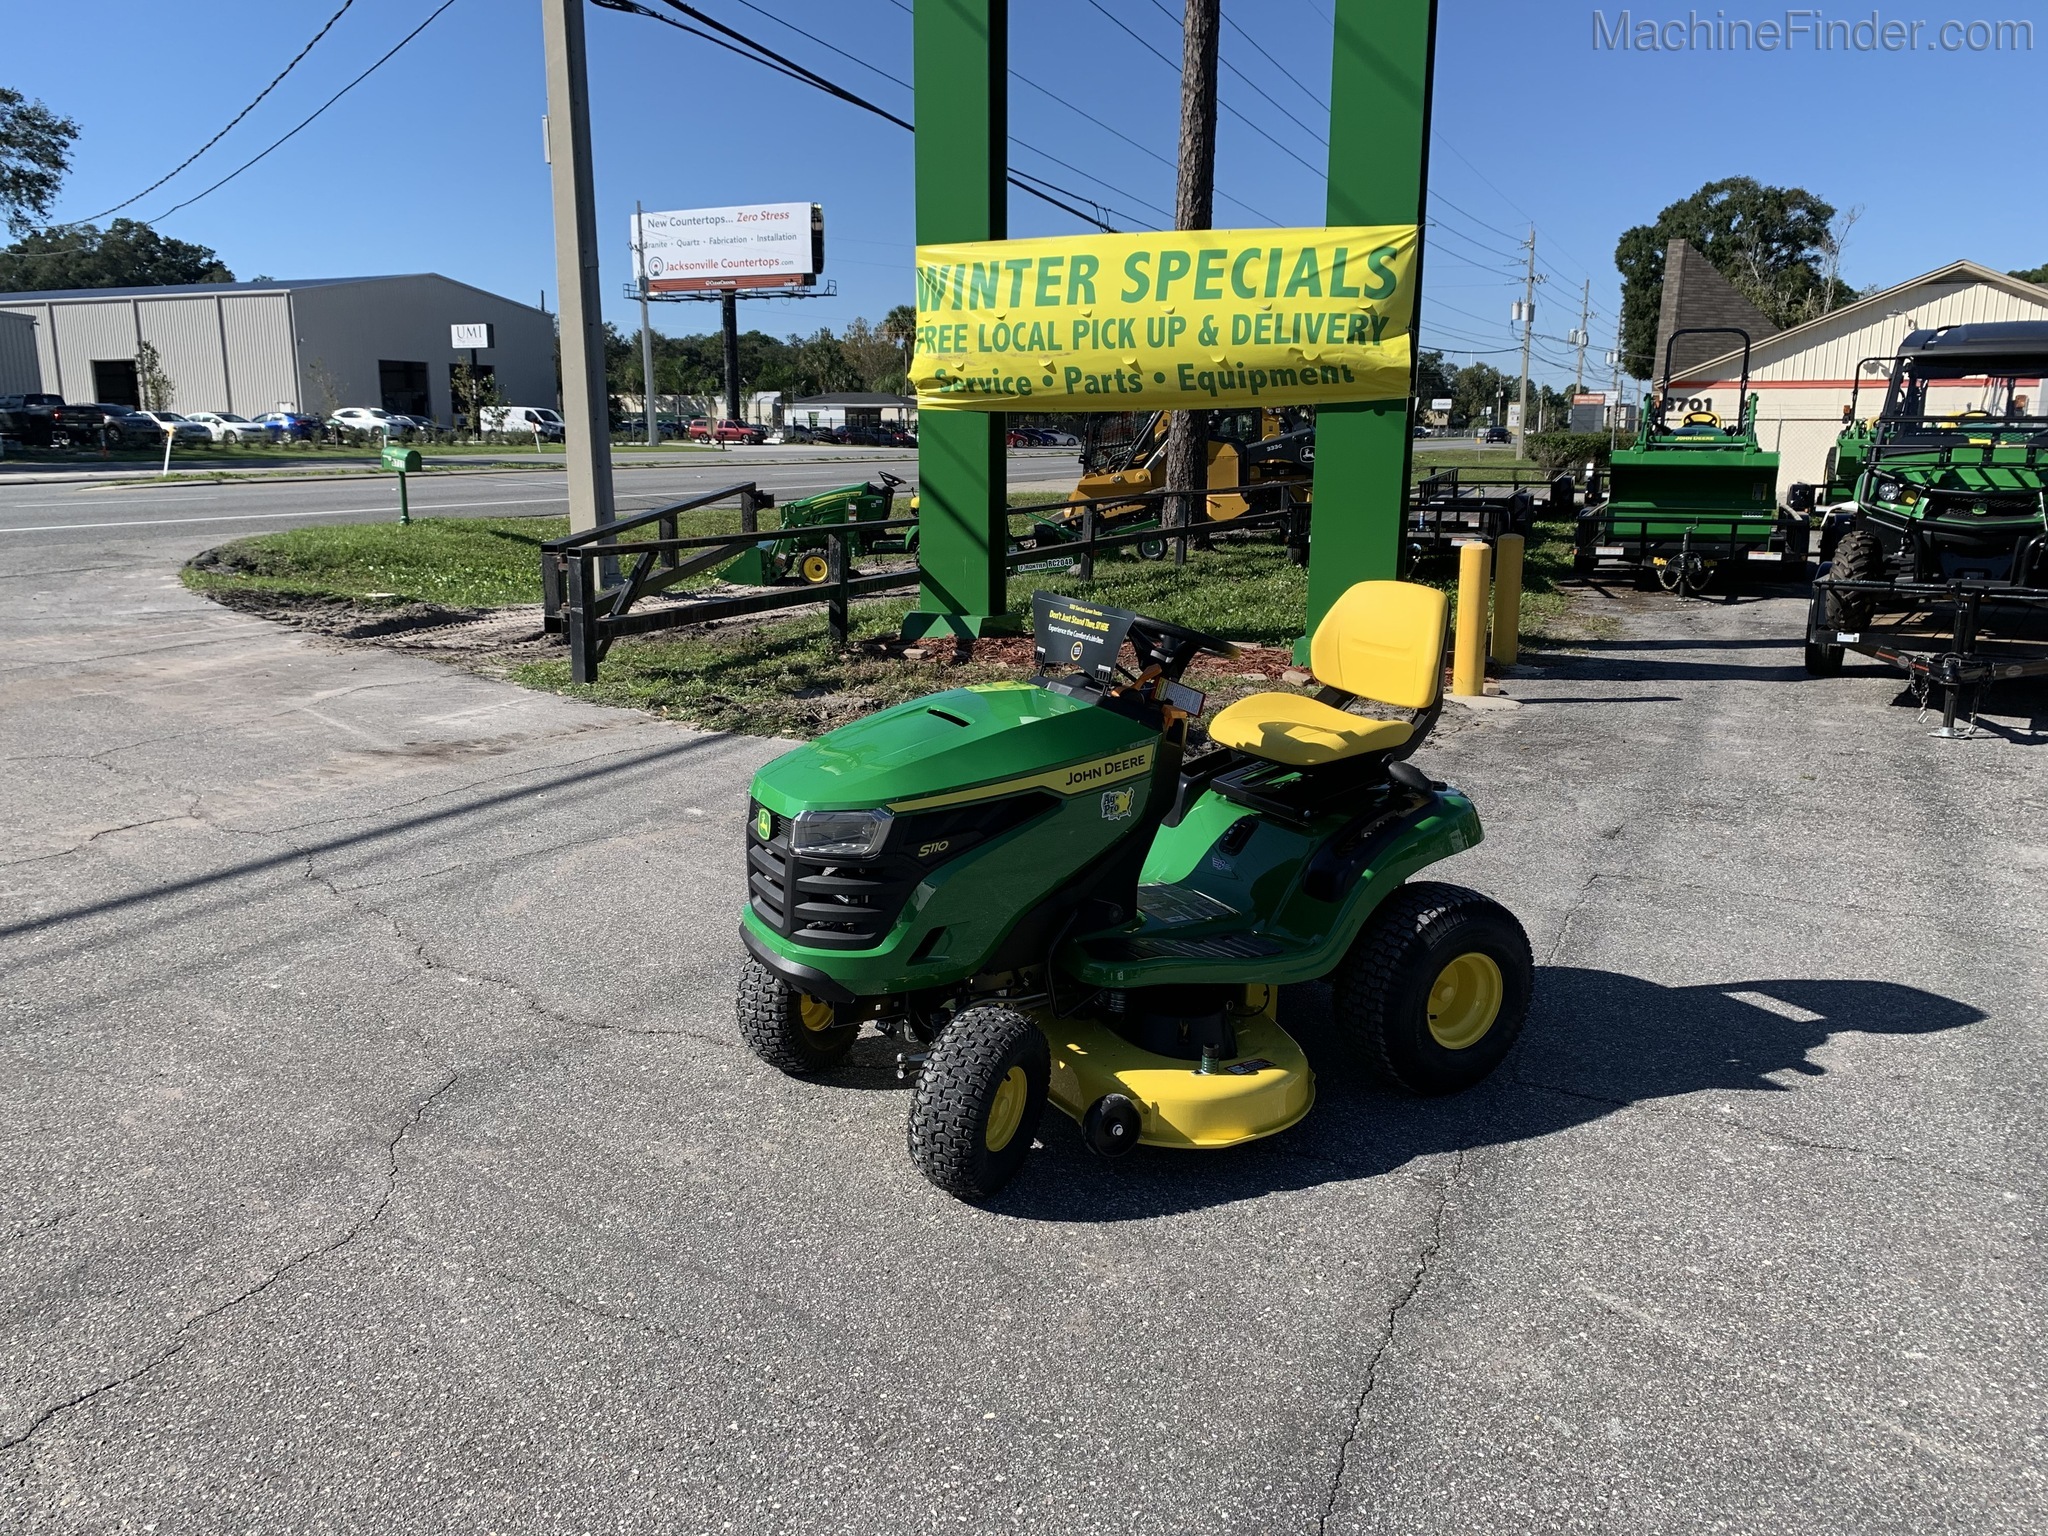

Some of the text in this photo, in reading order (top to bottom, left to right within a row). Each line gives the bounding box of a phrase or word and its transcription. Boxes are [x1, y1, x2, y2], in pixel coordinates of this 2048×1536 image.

[648, 219, 667, 229] New
[737, 212, 758, 223] Zero
[761, 210, 790, 220] Stress
[676, 239, 700, 248] Quartz
[709, 236, 748, 245] Fabrication
[756, 233, 797, 243] Installation
[665, 259, 719, 271] Jacksonville
[916, 245, 1398, 313] WINTER SPECIALS
[456, 325, 482, 339] UMI
[915, 312, 1391, 354] FREE LOCAL PICK UP & DELIVERY
[935, 361, 1355, 397] Service Parts Equipment
[1047, 557, 1074, 568] RC2048
[1049, 610, 1061, 619] Don't
[1061, 613, 1071, 622] Just
[1071, 615, 1084, 626] Stand
[1048, 623, 1066, 634] Experience
[1066, 755, 1146, 786] JOHN DEERE
[918, 840, 949, 857] S110
